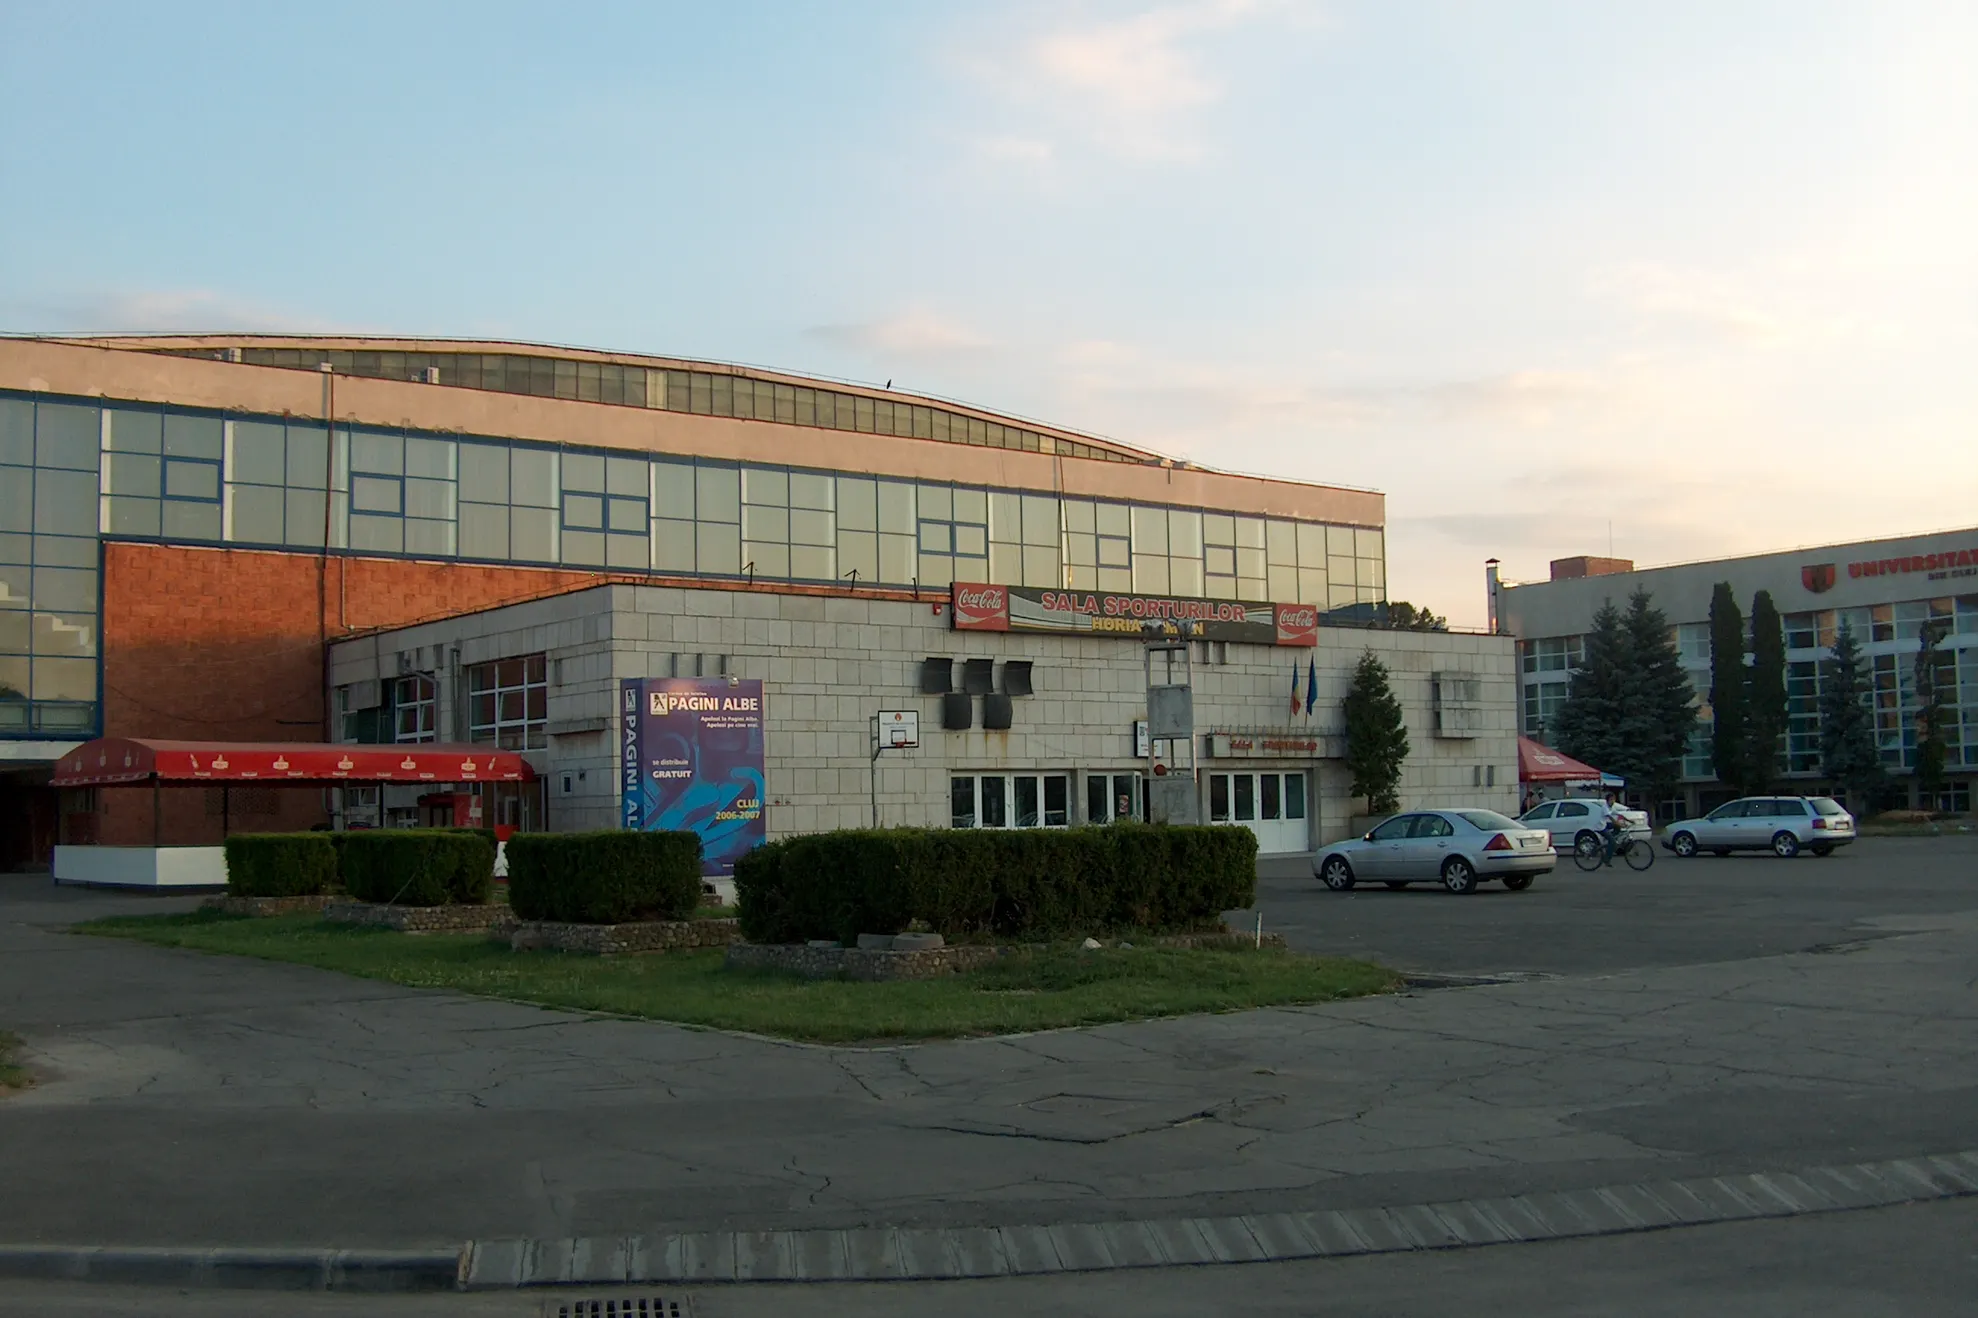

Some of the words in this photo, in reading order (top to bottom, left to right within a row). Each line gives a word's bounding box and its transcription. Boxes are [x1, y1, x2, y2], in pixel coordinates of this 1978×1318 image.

[1041, 592, 1100, 614] SALA
[1104, 597, 1246, 622] SPORTURILOR
[1092, 616, 1142, 632] HORIA
[669, 697, 719, 711] PAGINI
[723, 697, 758, 711] ALBE
[626, 715, 638, 791] PAGINI
[652, 770, 692, 778] GRATUIT
[736, 799, 760, 808] CLUJ
[627, 799, 638, 832] AL
[715, 811, 760, 820] 2006-2007
